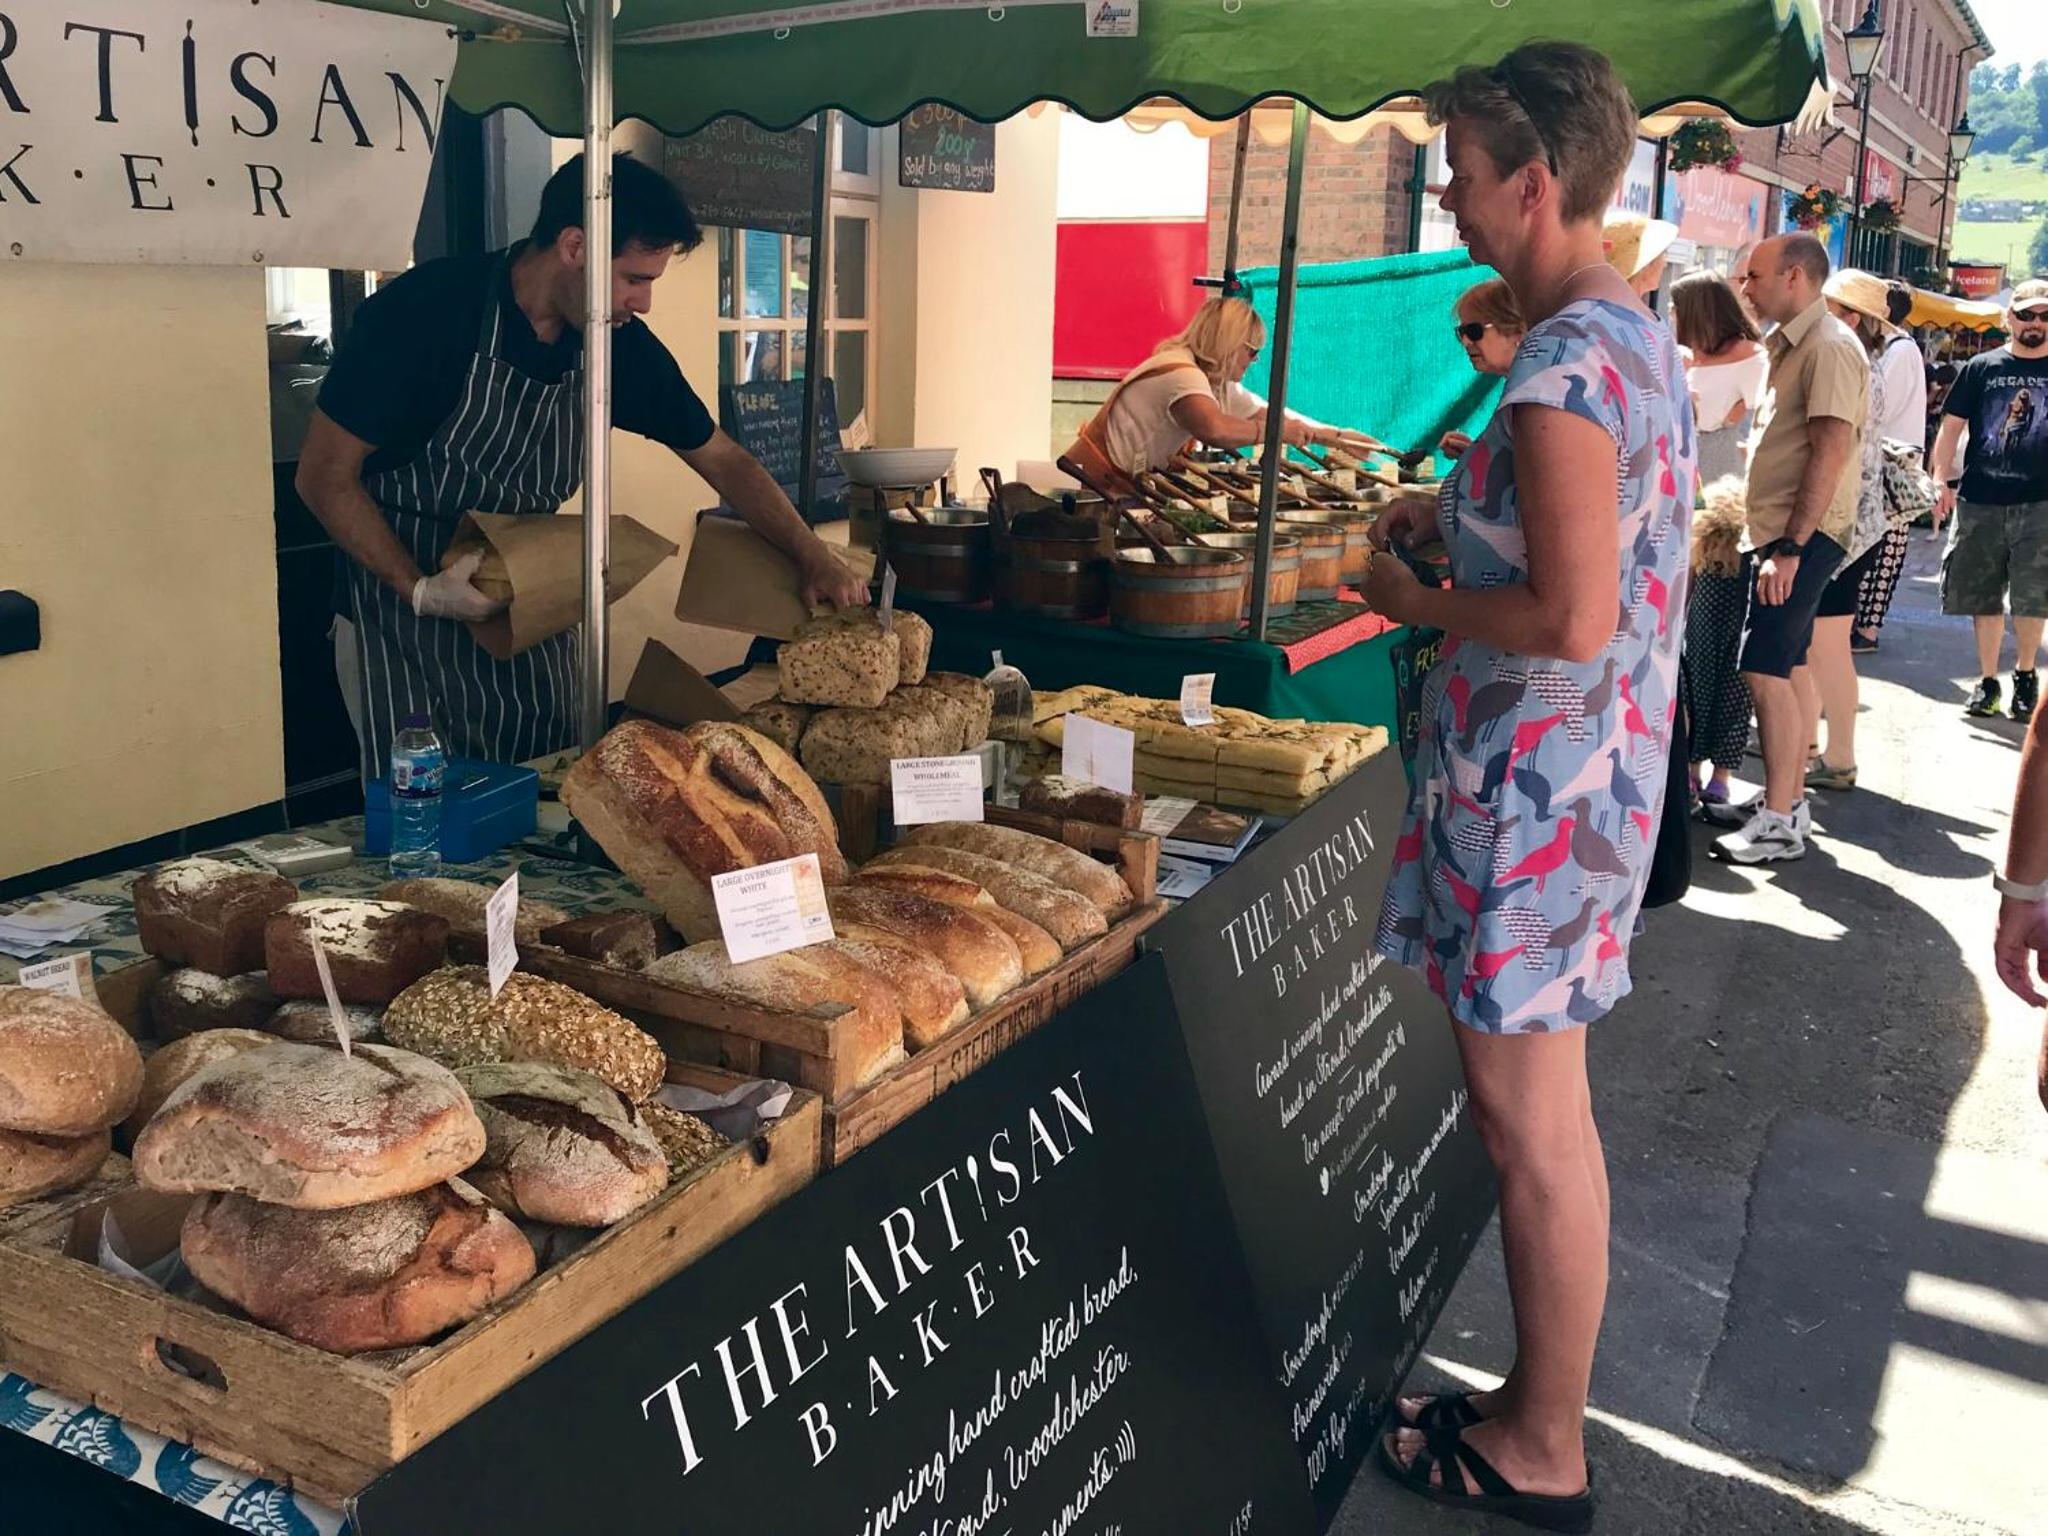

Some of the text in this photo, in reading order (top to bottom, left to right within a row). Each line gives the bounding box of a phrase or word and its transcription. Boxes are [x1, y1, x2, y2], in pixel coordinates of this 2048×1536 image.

[1984, 375, 2048, 392] MEGADE
[716, 864, 791, 889] LARGE OVERNIGHT
[739, 881, 768, 895] WHITE
[1221, 809, 1375, 978] THE ARTISAN
[23, 961, 71, 982] WALNUT BREAD
[641, 1070, 1095, 1475] THE ARTISAN
[854, 1245, 1138, 1536] inning hand crafted bread,
[1004, 1344, 1132, 1490] Woodchester.
